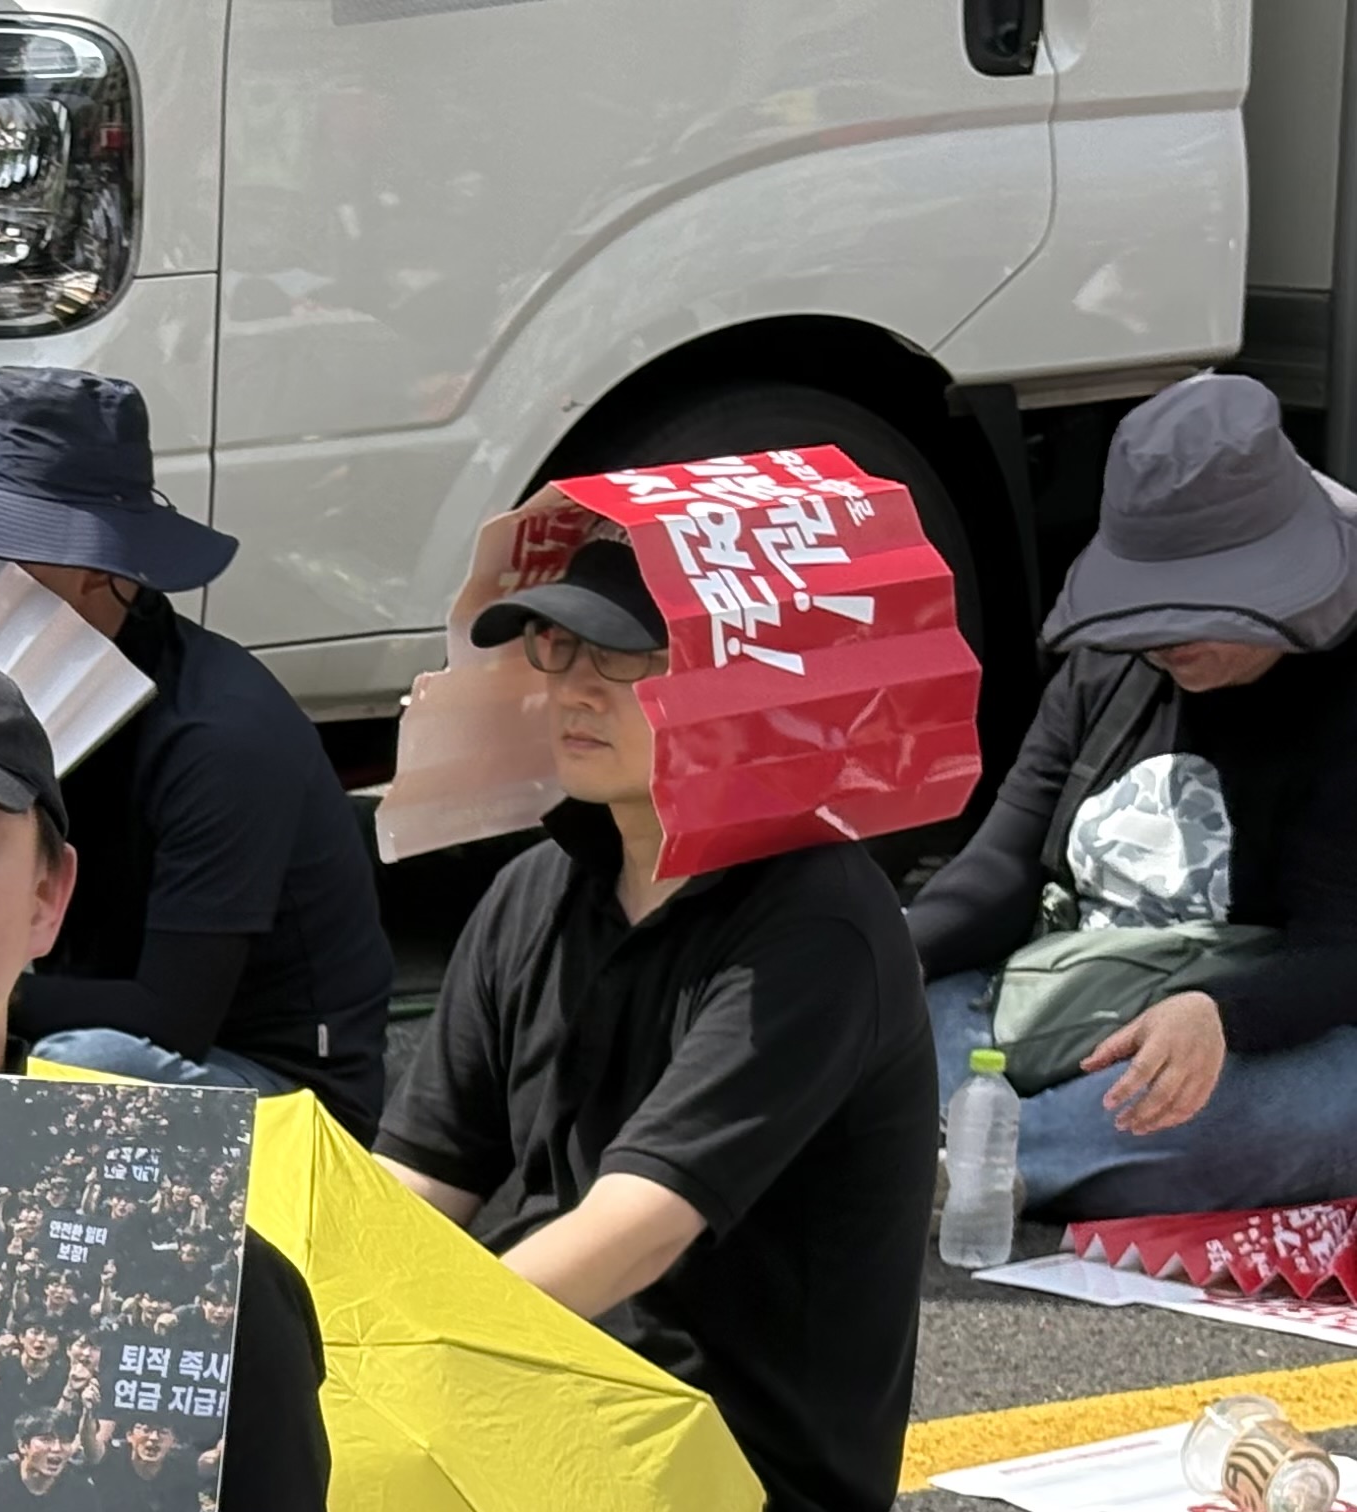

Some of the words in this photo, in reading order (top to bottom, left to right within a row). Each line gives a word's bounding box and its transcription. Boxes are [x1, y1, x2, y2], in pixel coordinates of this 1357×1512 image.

[118, 1343, 172, 1373] 퇴직
[178, 1350, 230, 1382] 즉시
[113, 1379, 163, 1410] 연금
[168, 1386, 227, 1418] 지급!
